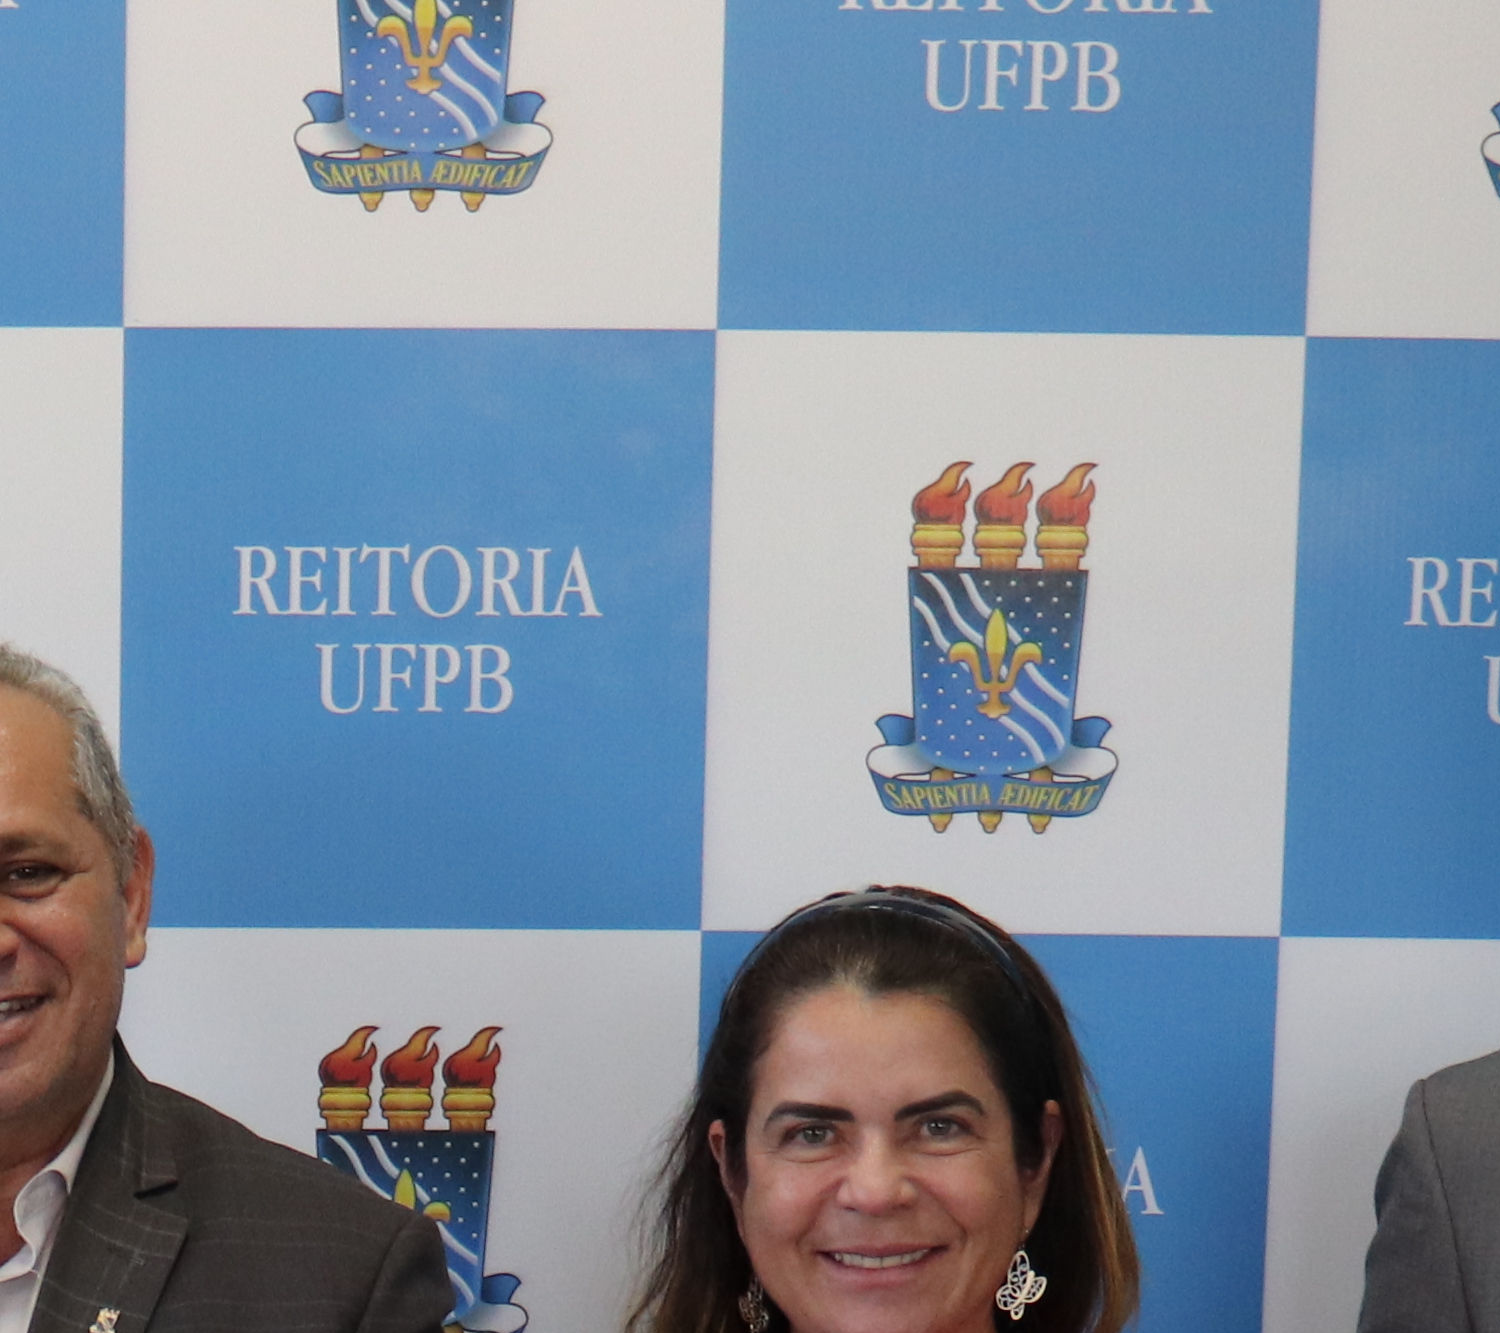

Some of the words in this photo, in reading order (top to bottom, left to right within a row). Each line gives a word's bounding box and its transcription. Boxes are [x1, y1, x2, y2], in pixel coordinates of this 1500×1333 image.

[920, 39, 1121, 113] UFPB
[313, 159, 423, 188] SAPIENTIA
[232, 543, 603, 619] REITORIA
[315, 643, 514, 714] UFPB
[883, 782, 991, 811] SAPIENTIA
